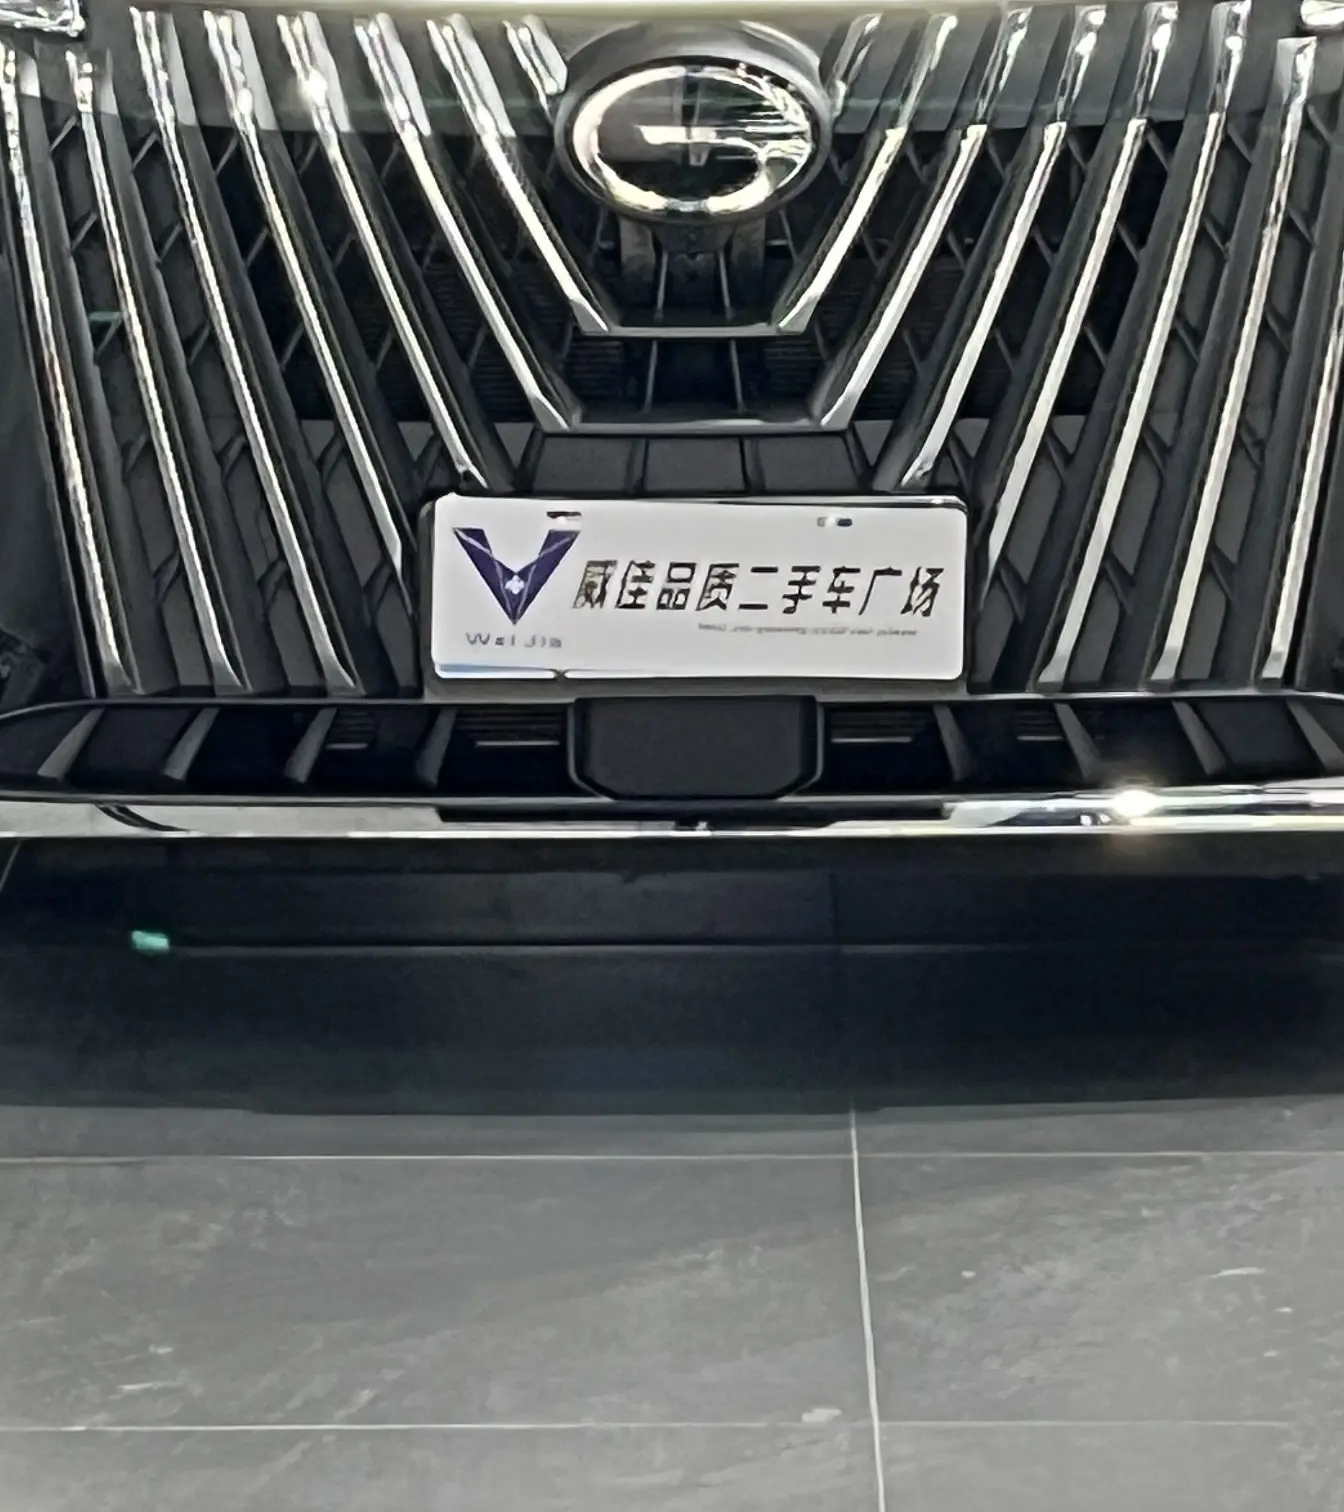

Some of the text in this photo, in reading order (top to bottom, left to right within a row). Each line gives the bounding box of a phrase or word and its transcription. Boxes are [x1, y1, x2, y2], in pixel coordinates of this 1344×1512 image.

[573, 559, 945, 618] 威佳品质二手车广场
